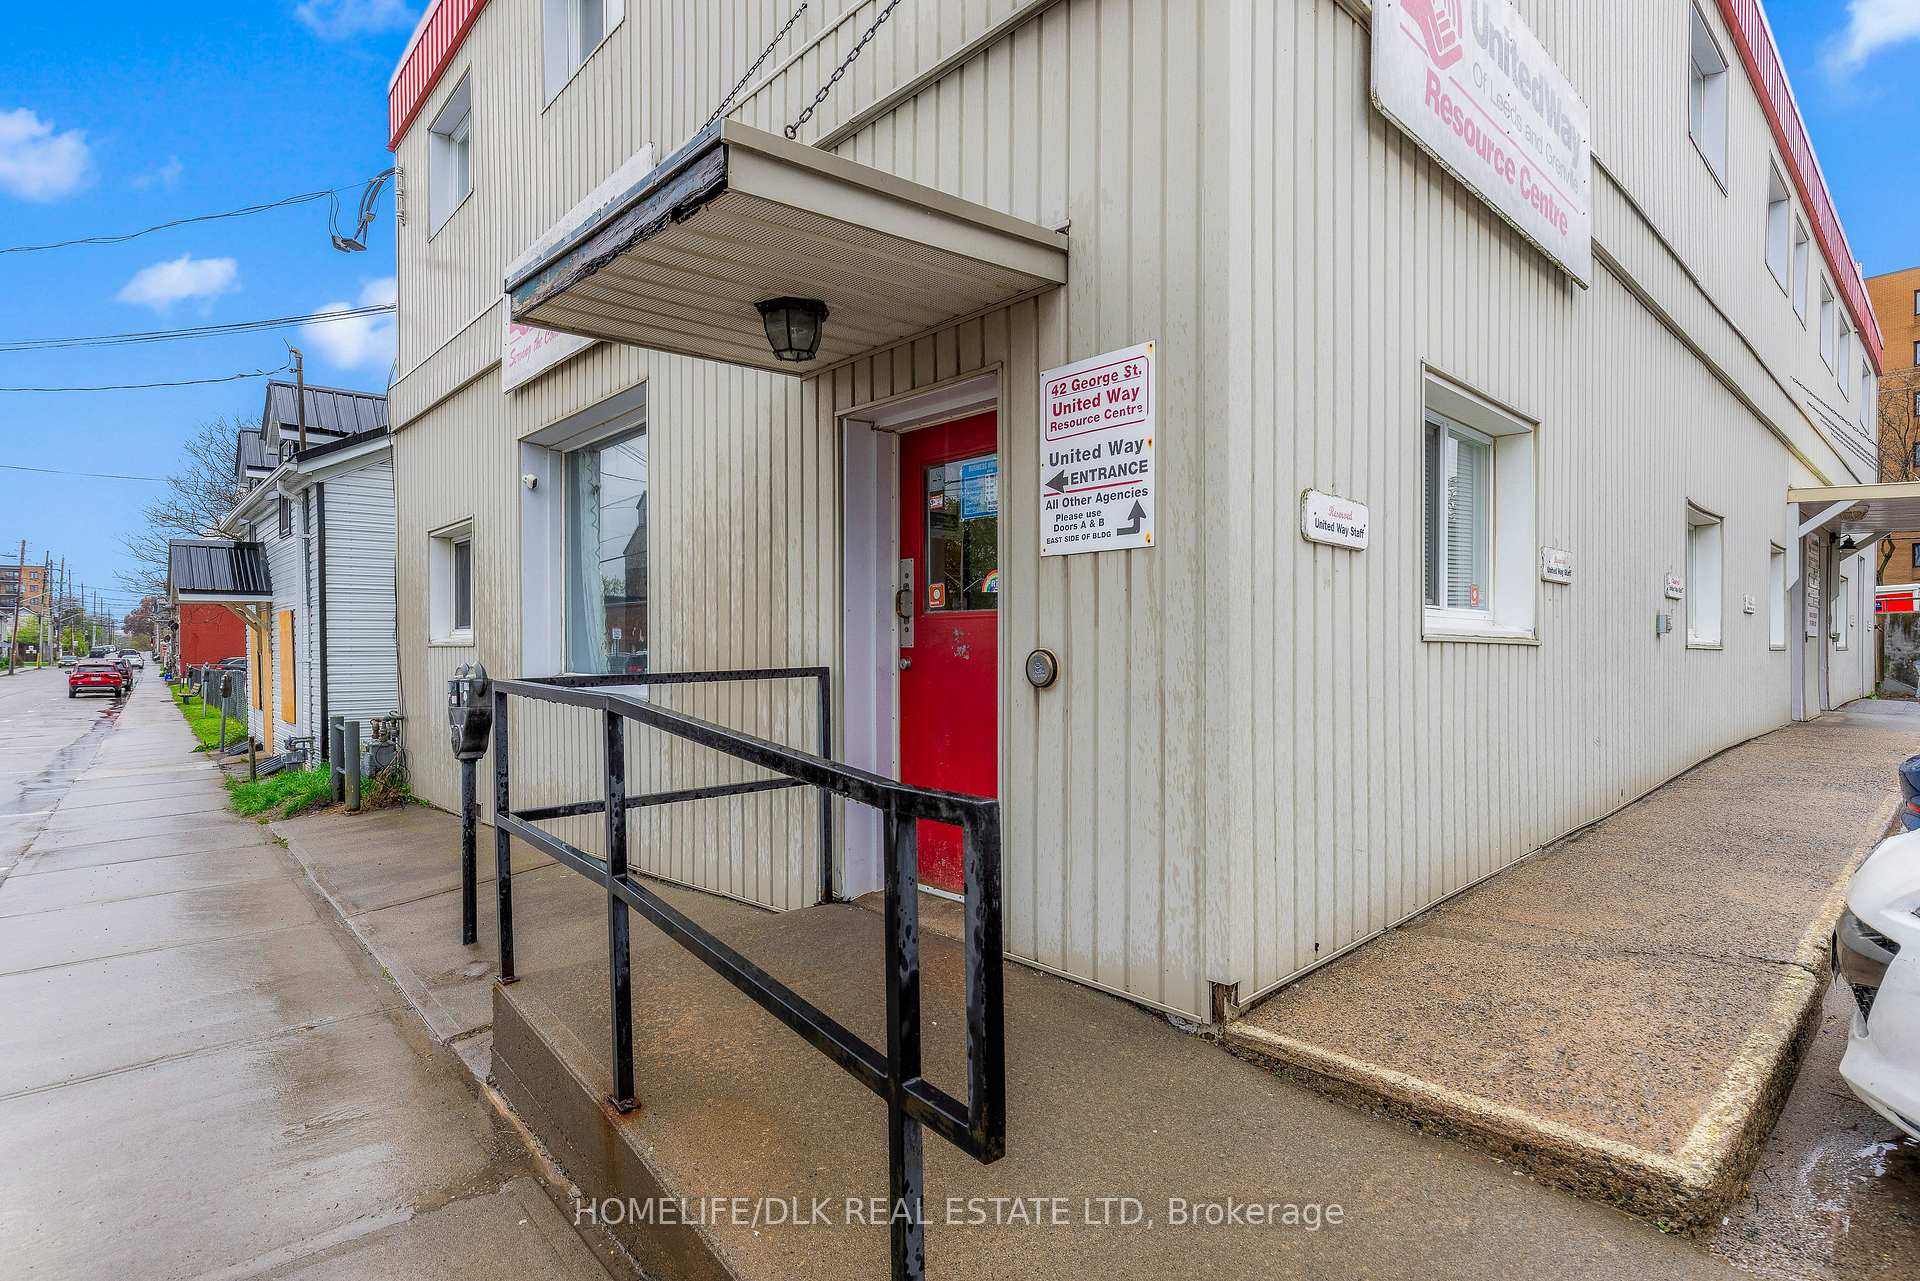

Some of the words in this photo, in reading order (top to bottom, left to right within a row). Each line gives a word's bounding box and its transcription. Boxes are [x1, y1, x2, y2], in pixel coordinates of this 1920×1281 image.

[1425, 67, 1516, 185] Resource
[1520, 164, 1569, 237] Centre
[1525, 124, 1543, 154] and
[1051, 382, 1067, 397] 42
[1071, 370, 1119, 392] George
[1124, 364, 1142, 379] St.
[1052, 392, 1101, 417] United
[1106, 386, 1140, 404] Way
[1050, 413, 1100, 432] Resource
[1104, 404, 1143, 420] Centre
[1049, 443, 1101, 467] United
[1108, 438, 1144, 457] Way
[1070, 459, 1149, 486] ENTRANCE
[1045, 498, 1059, 511] All
[1062, 493, 1092, 508] Other
[1095, 487, 1149, 505] Agencies
[1053, 522, 1078, 533] Doors
[1080, 520, 1087, 529] A
[1089, 519, 1096, 528] &
[1098, 518, 1105, 527] B
[1055, 510, 1083, 522] Please
[1086, 509, 1102, 519] use
[1314, 517, 1335, 532] United
[1336, 523, 1349, 537] Way
[1350, 526, 1365, 539] Staff
[1046, 535, 1063, 545] EAST
[1064, 534, 1080, 543] SIDE
[1081, 533, 1091, 541] OF
[1092, 530, 1112, 540] BLDG
